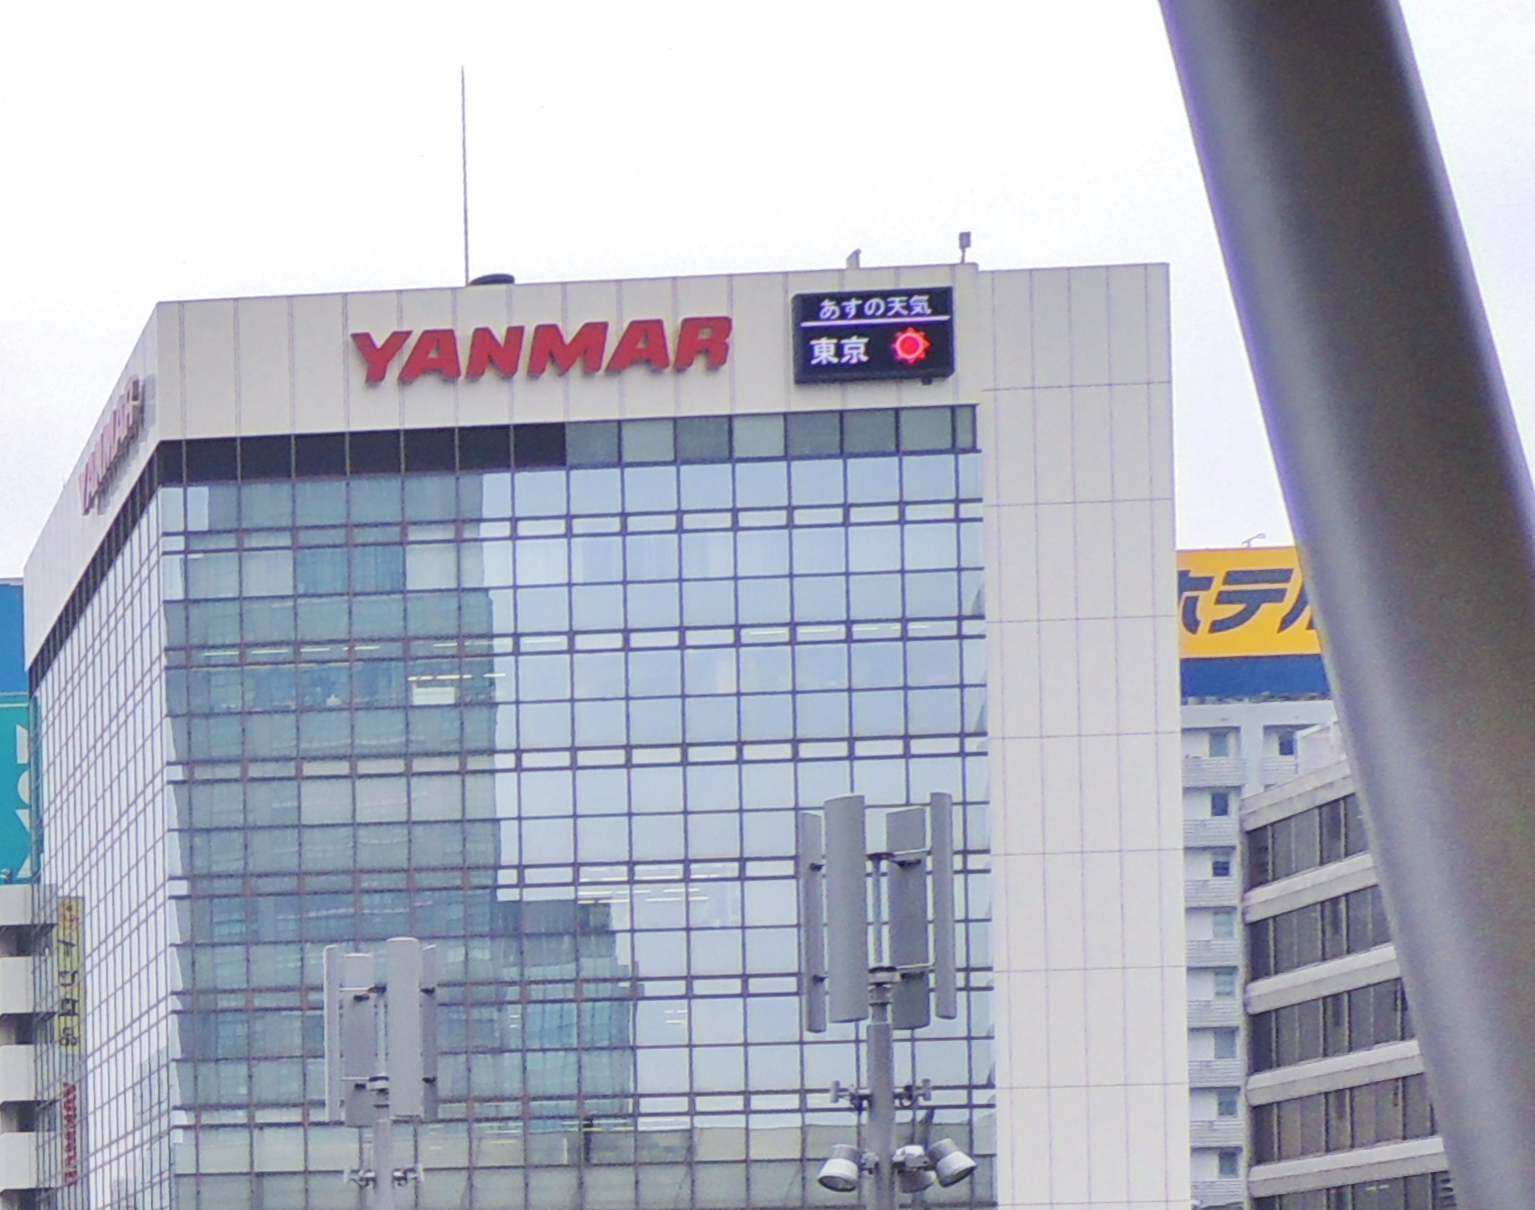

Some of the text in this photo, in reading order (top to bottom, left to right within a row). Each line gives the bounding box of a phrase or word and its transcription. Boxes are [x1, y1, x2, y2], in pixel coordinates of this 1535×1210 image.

[818, 294, 932, 322] あすの天気
[351, 316, 732, 385] YANMAR
[810, 336, 869, 366] 東京
